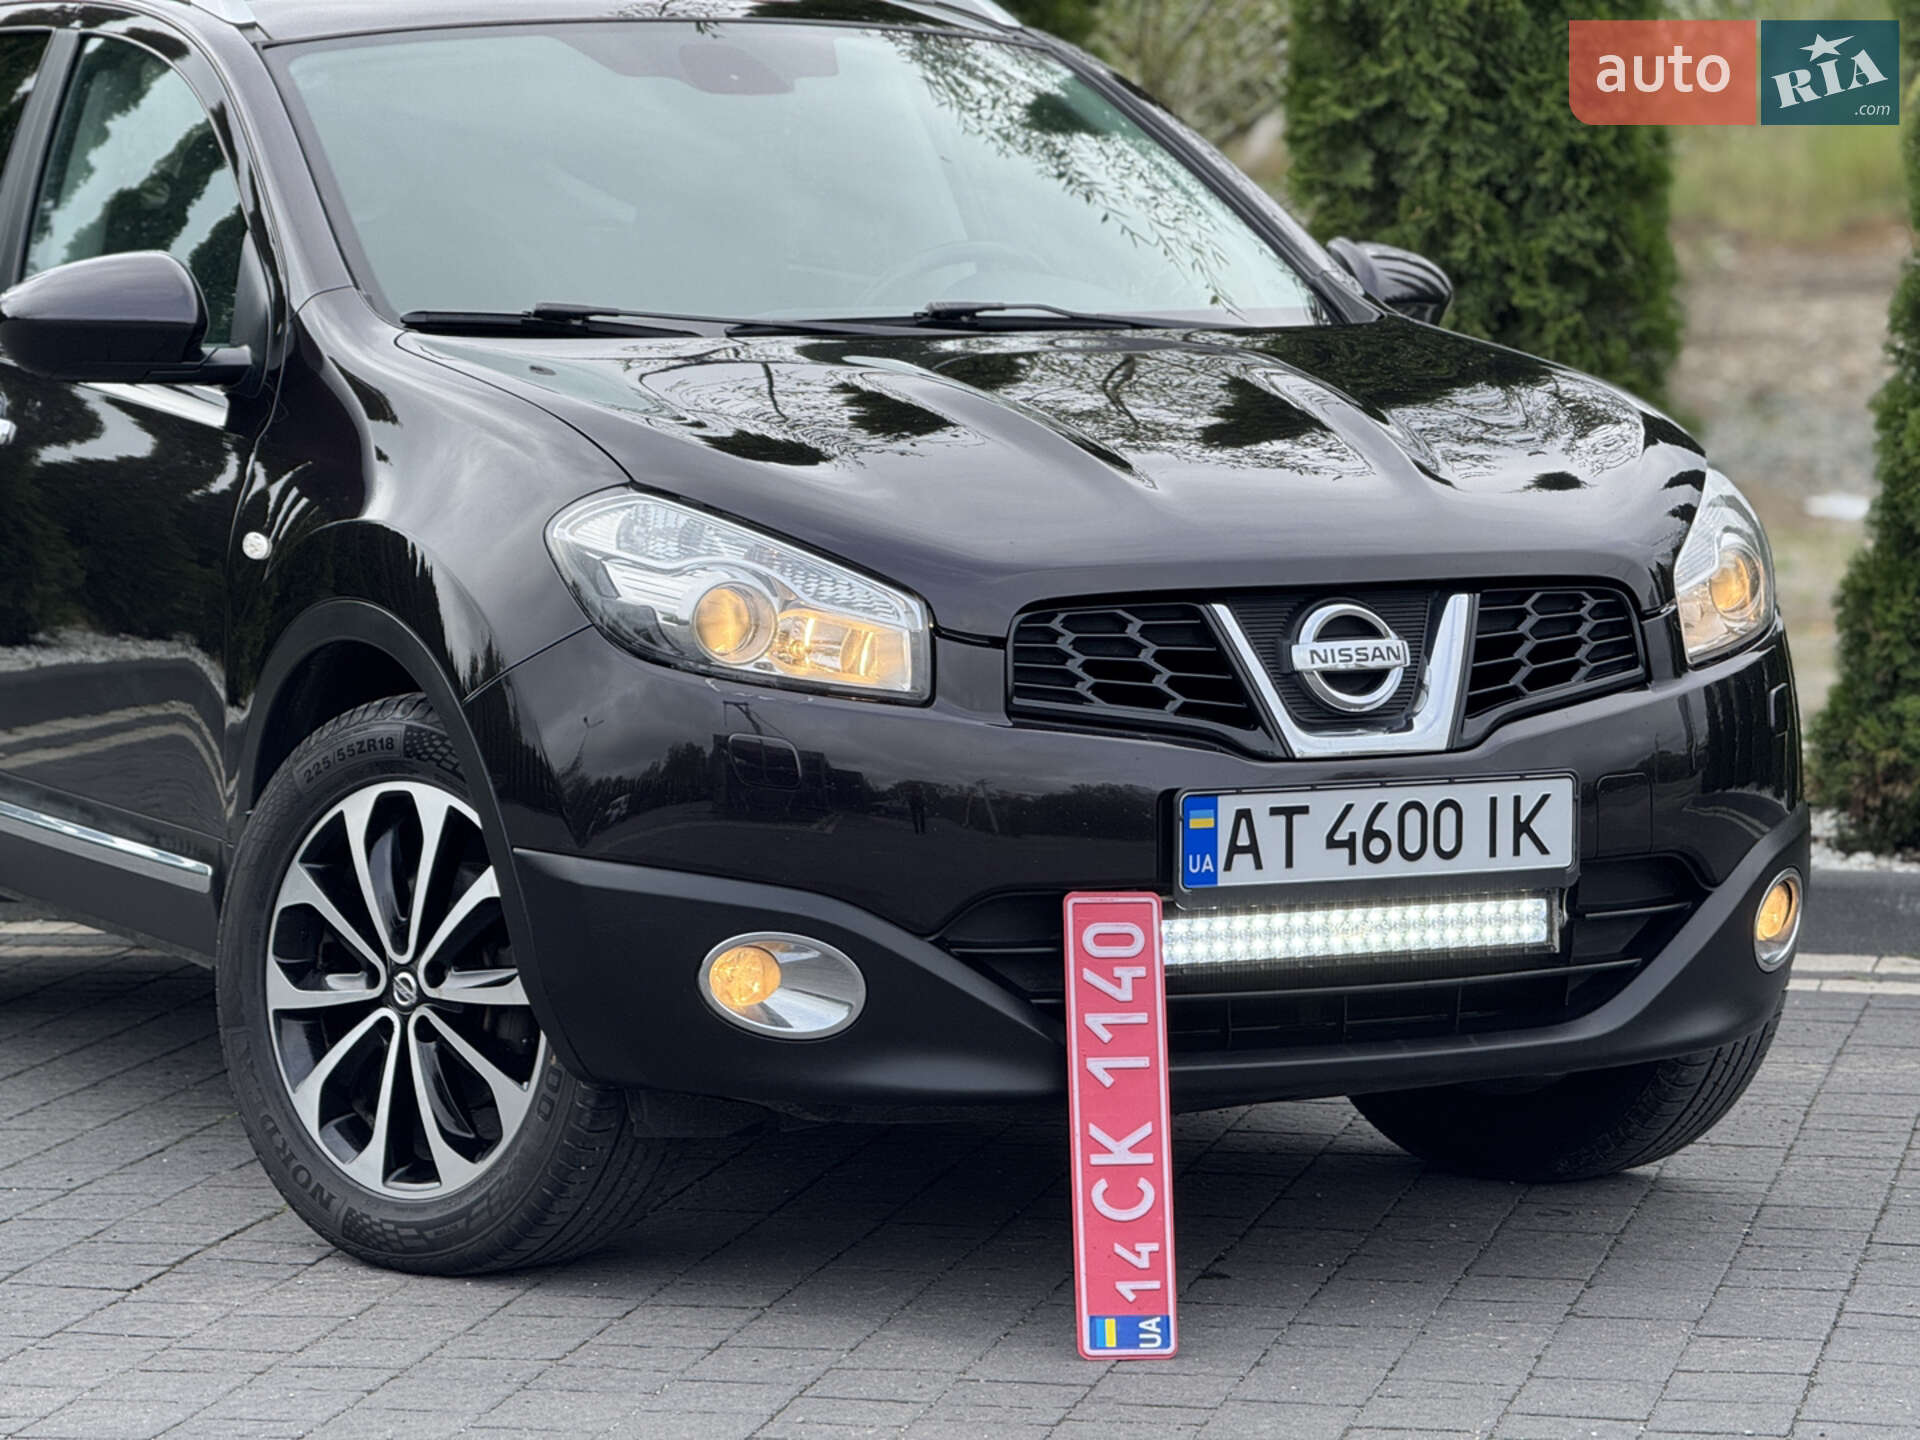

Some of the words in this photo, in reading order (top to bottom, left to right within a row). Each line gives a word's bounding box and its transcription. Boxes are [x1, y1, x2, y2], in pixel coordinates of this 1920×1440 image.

[1309, 646, 1402, 664] NISSAN
[303, 737, 395, 784] 225/55ZR18
[1188, 853, 1215, 873] UA
[1222, 806, 1311, 873] AT
[1325, 798, 1463, 867] 4600
[1488, 792, 1552, 858] IK
[1082, 921, 1151, 1090] 1140
[1089, 1120, 1155, 1222] CK
[1113, 1242, 1161, 1303] 14
[1138, 1316, 1162, 1349] UA
